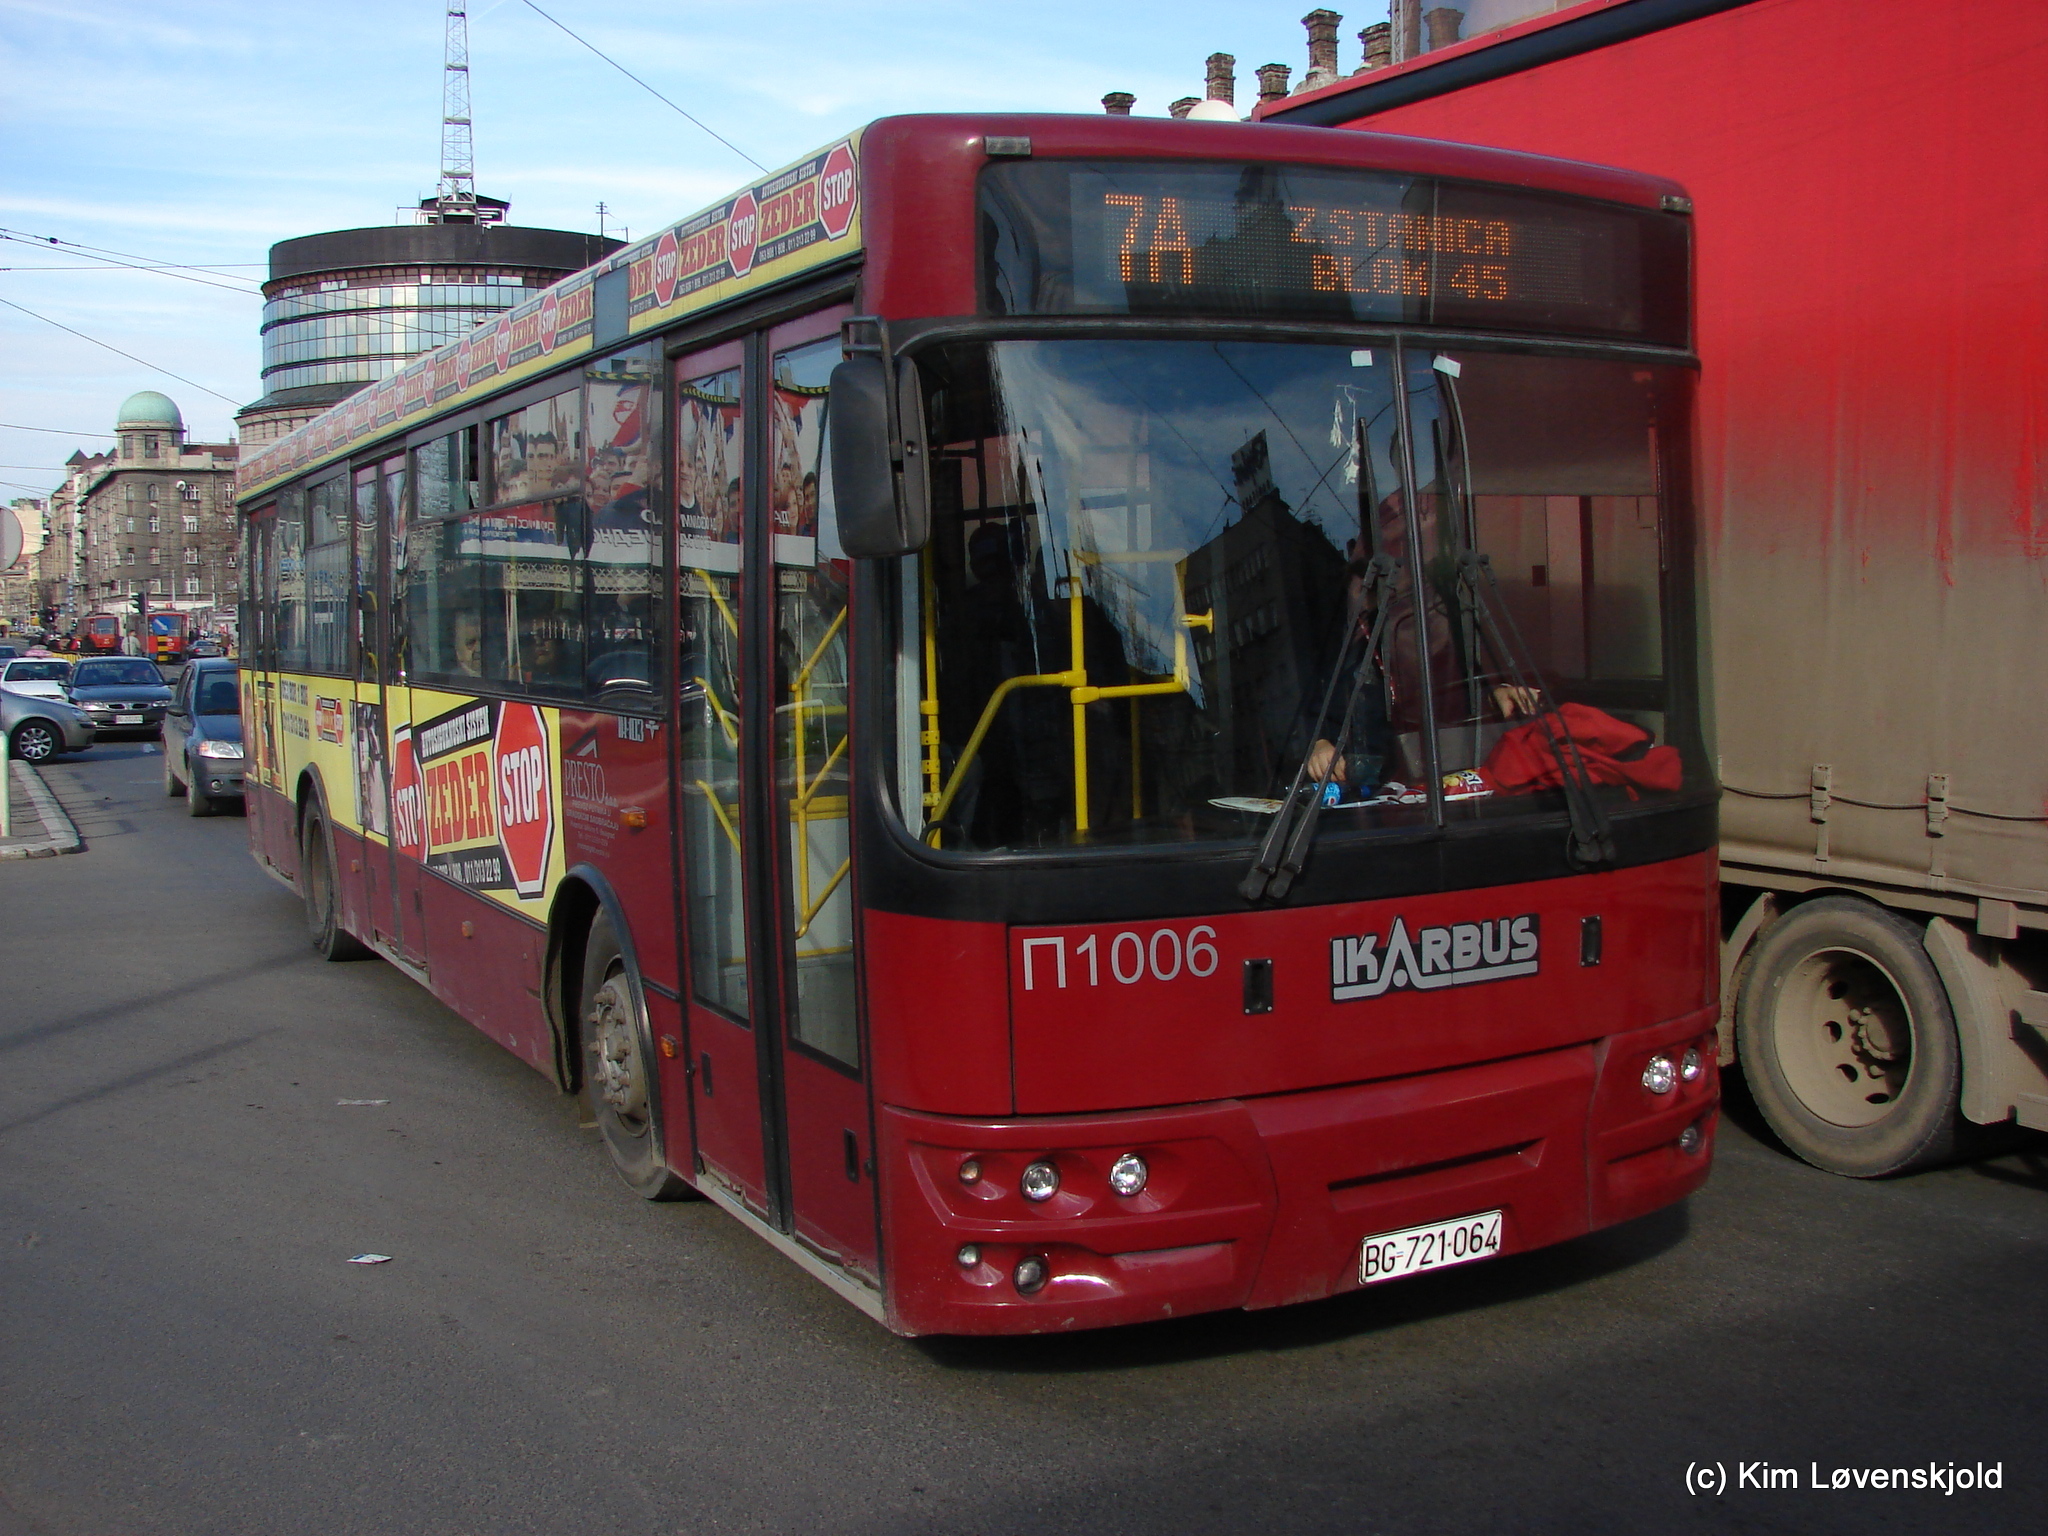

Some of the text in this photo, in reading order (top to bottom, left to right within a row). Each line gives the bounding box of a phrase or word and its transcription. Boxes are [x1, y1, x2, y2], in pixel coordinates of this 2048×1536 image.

[761, 181, 816, 243] ZEDER
[823, 168, 852, 211] STOP
[680, 224, 726, 278] ZEDER
[731, 213, 755, 251] STOP
[1105, 193, 1192, 285] 7A
[630, 258, 653, 300] DER
[657, 251, 676, 284] STOP
[1312, 253, 1508, 300] BLOK 45
[542, 307, 556, 335] STOP
[426, 751, 494, 847] ZEDER
[501, 745, 542, 827] STOP
[564, 758, 606, 804] PRESTO
[397, 783, 422, 848] STOP
[1332, 916, 1538, 1000] IKARBUS
